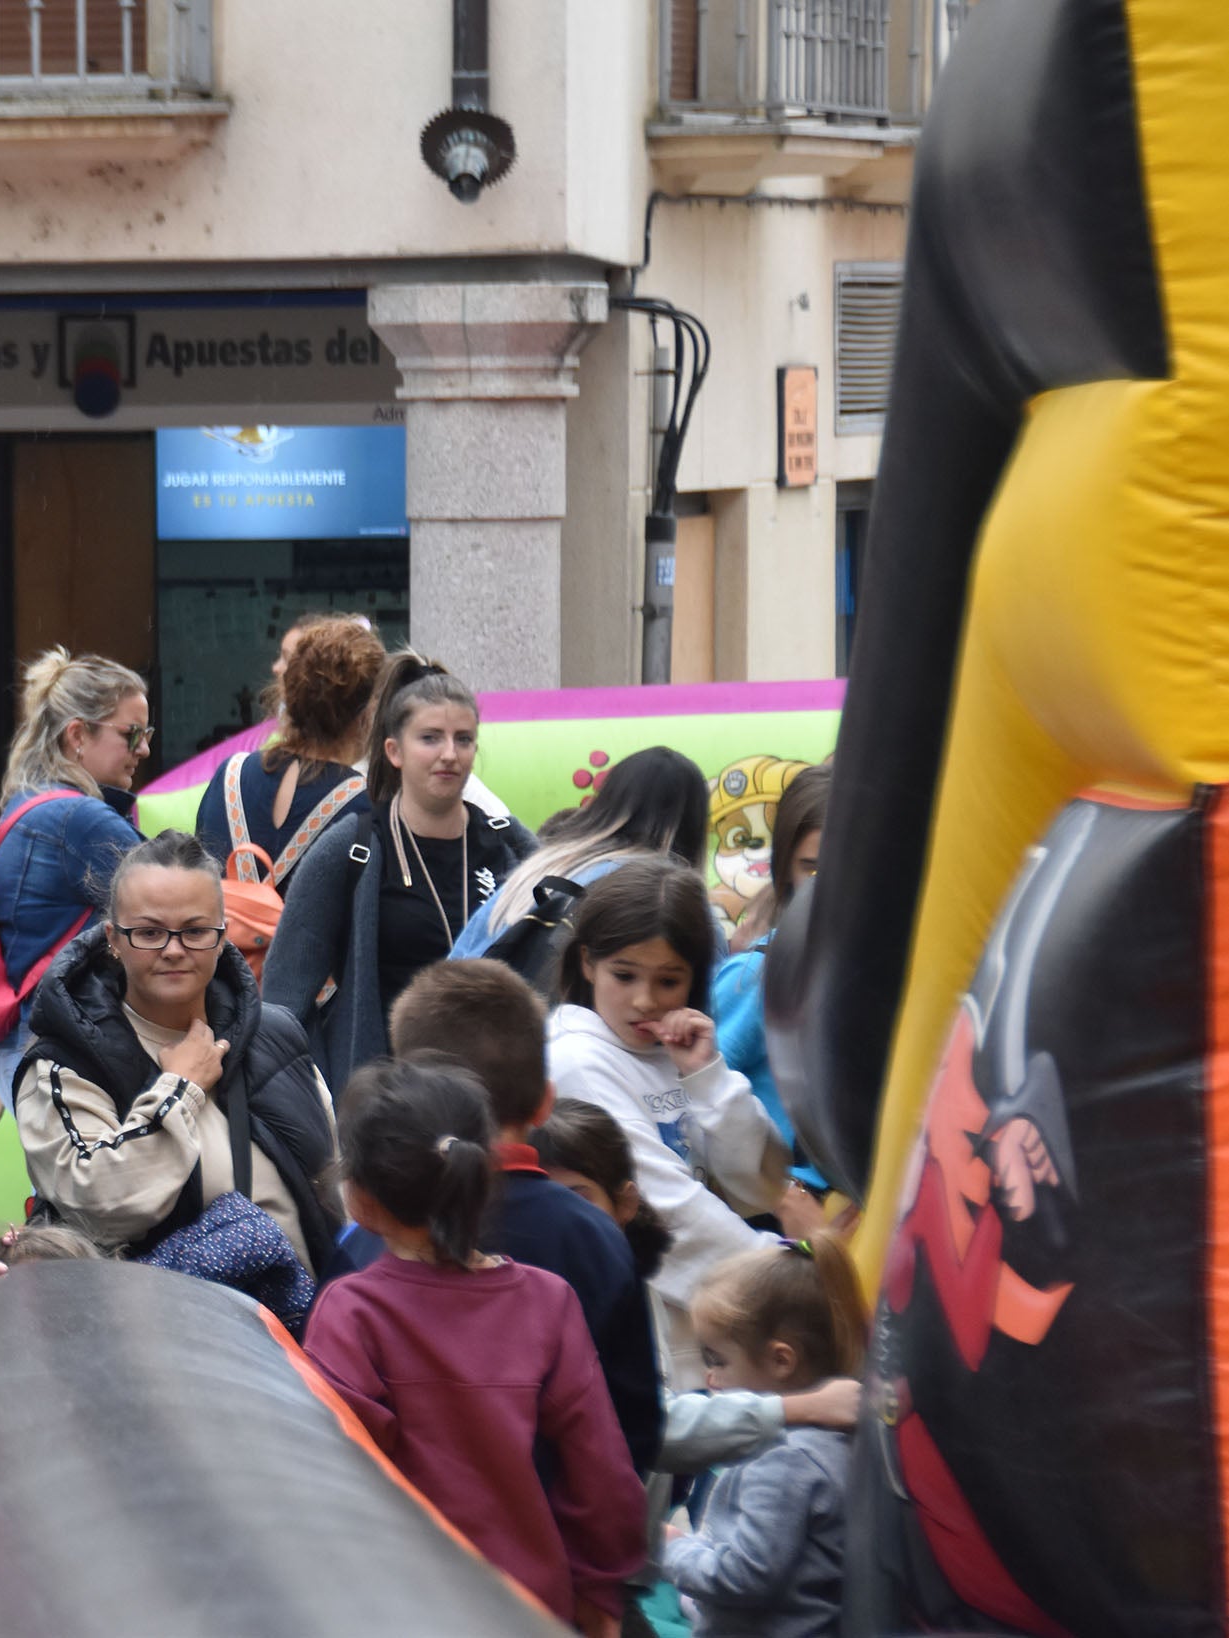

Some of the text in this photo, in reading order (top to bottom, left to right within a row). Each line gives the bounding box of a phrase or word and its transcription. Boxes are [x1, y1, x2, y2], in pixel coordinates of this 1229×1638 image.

[29, 341, 52, 379] y
[145, 332, 313, 377] Apuestas
[324, 327, 381, 366] del
[163, 469, 347, 488] JUGAR RESPONSABLEMENTE
[192, 492, 316, 509] ES TU APUESTA
